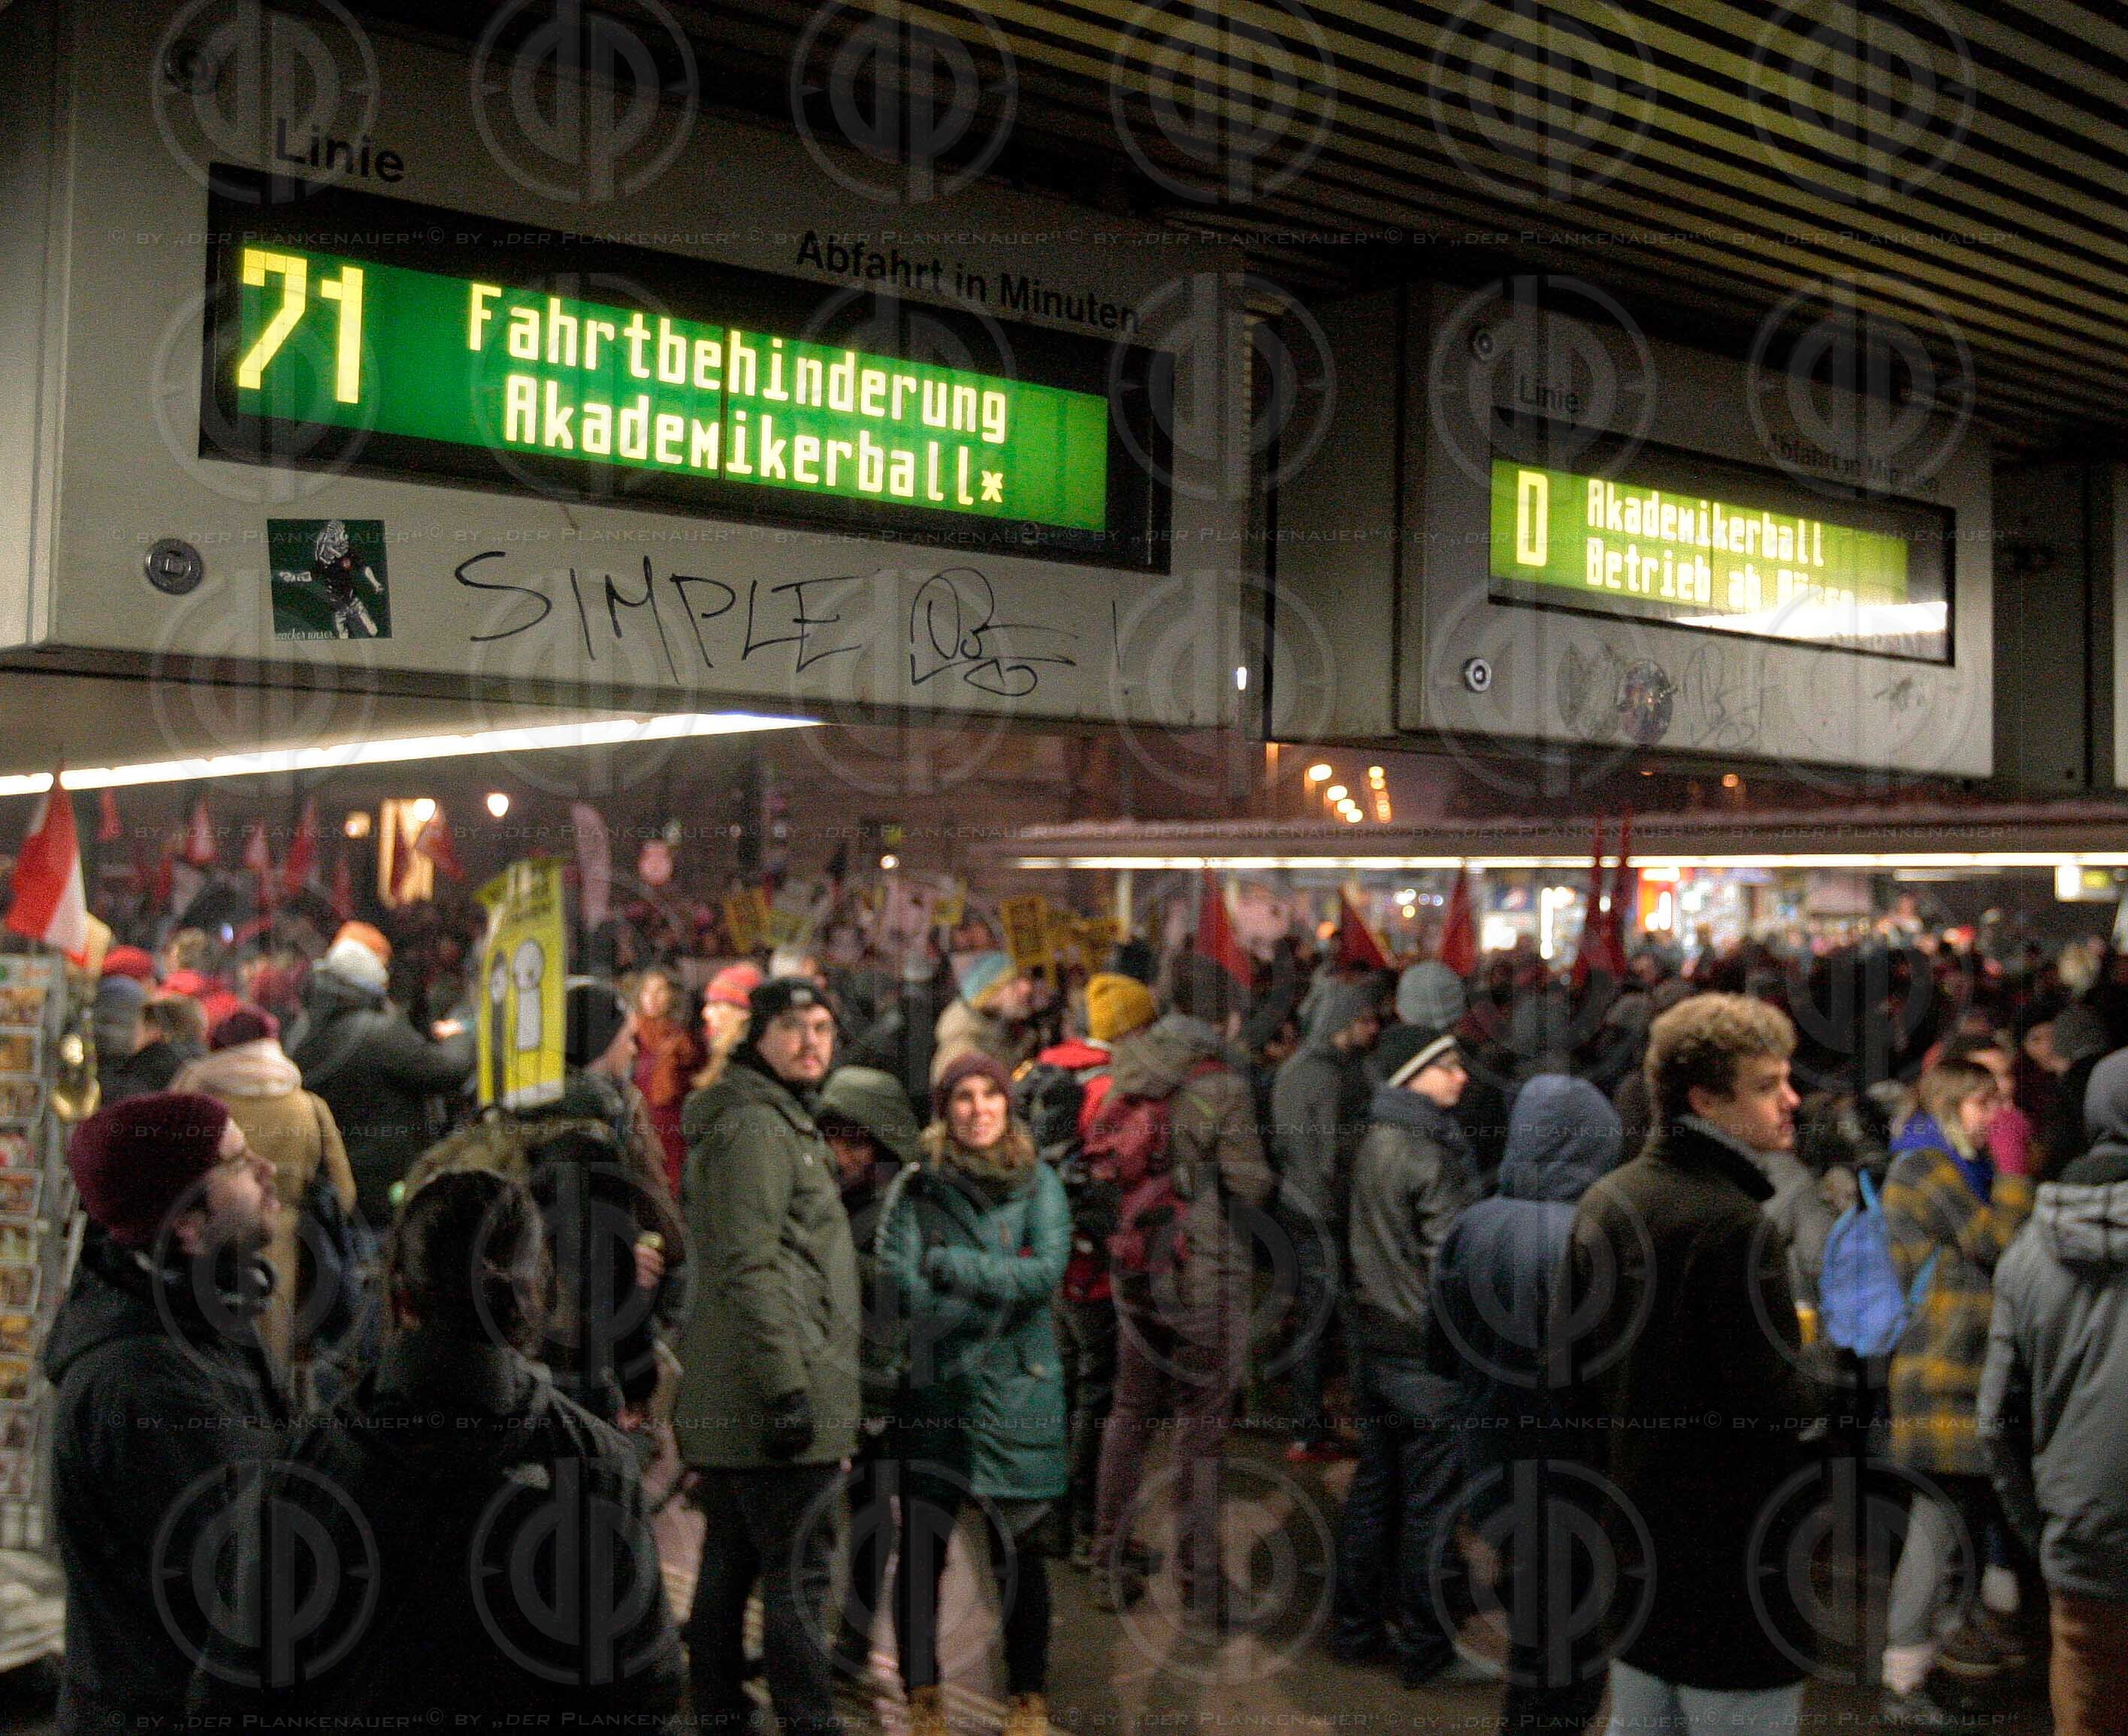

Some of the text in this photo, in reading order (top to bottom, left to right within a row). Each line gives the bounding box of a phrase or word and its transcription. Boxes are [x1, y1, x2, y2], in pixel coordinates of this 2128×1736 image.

[275, 116, 405, 183] Linie
[237, 248, 364, 404] 71
[796, 229, 1140, 334] Abfahrt in Minuten
[469, 283, 1007, 444] Fahrtbehinderung
[1585, 537, 1712, 602] Betrieb
[1586, 479, 1824, 567] Akademikerball
[454, 551, 863, 685] SIMPLE
